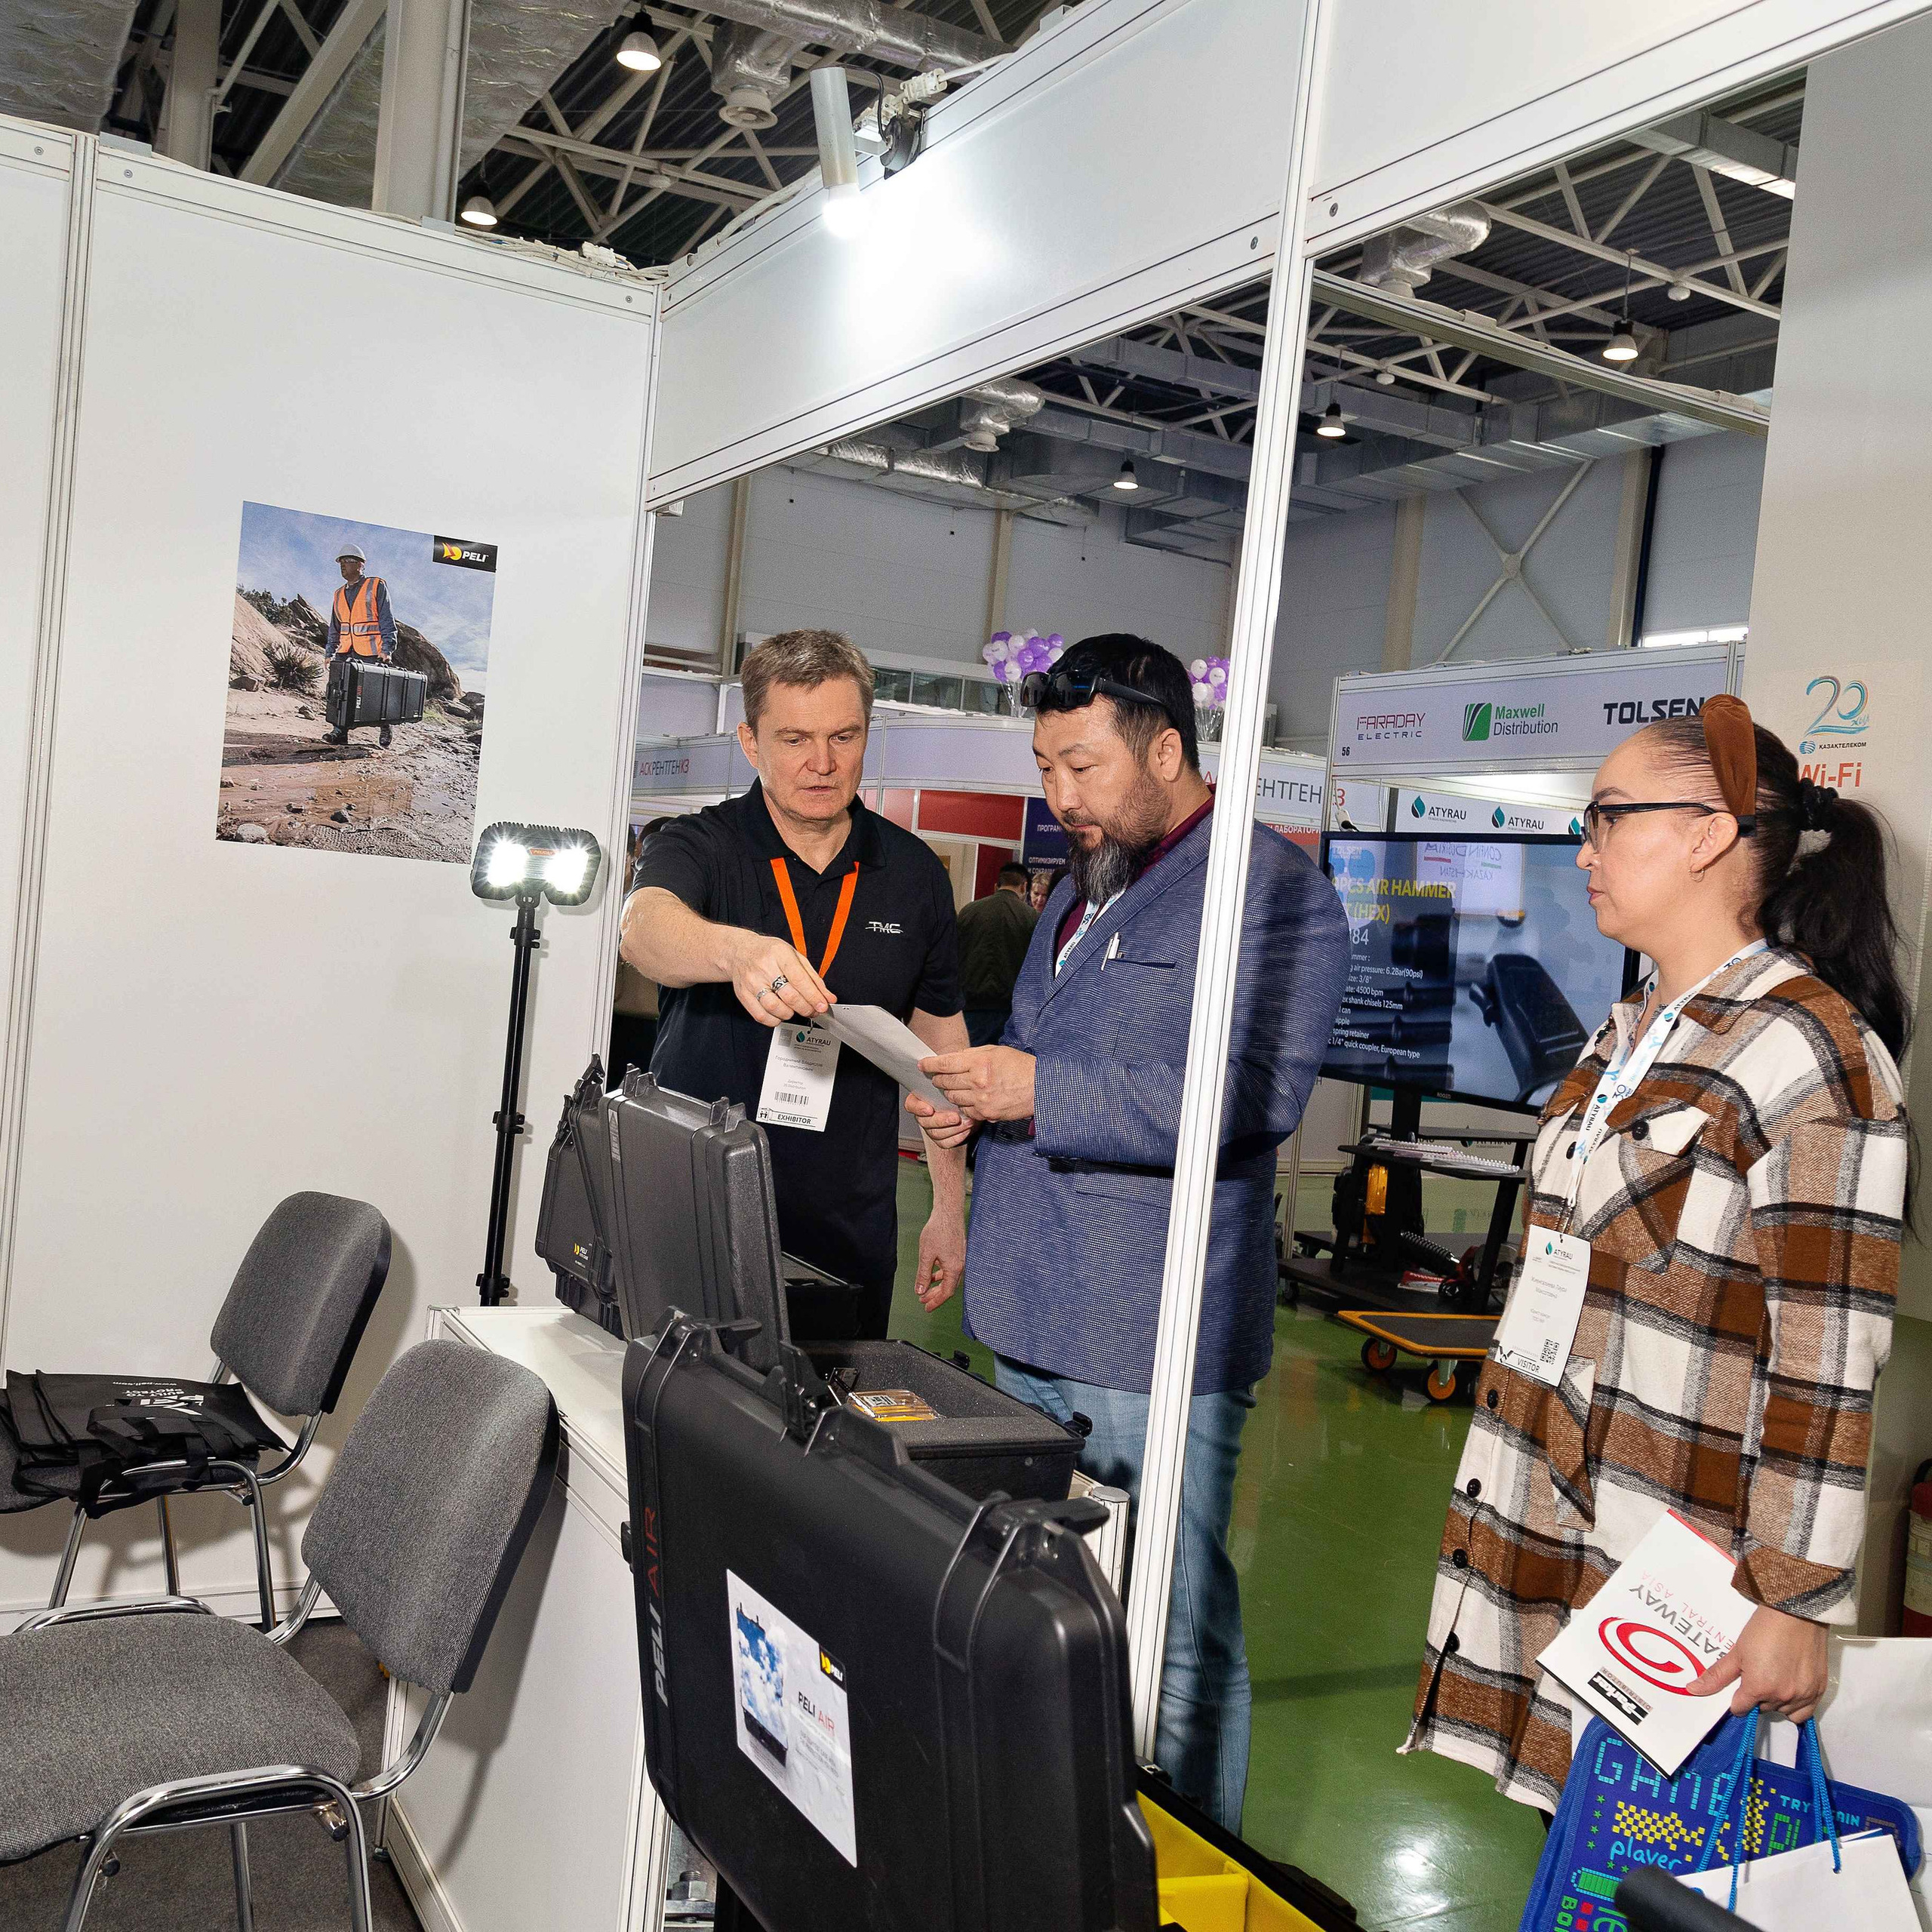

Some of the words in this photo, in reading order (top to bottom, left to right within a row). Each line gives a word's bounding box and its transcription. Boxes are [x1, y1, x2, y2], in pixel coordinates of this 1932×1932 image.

[461, 550, 489, 563] PELI
[1495, 703, 1545, 720] Maxwell
[1603, 697, 1705, 725] TOLSEN
[1357, 712, 1426, 730] FARADAY
[1493, 721, 1558, 736] Distribution
[1358, 731, 1422, 740] ELECTRIC
[1342, 747, 1350, 756] 56
[1798, 762, 1862, 788] Wi-Fi
[1428, 807, 1466, 820] ATYRAU
[1508, 817, 1544, 829] ATYRAU
[1367, 878, 1389, 896] AIR
[1391, 879, 1457, 899] HAMMER
[1349, 928, 1369, 945] 84
[1361, 965, 1386, 975] pressure:
[1355, 986, 1371, 995] 4500
[1371, 987, 1384, 996] bpm
[1349, 996, 1364, 1005] shank
[1364, 998, 1382, 1008] chisels
[1383, 1000, 1403, 1011] 125mm
[806, 1036, 832, 1046] ATYRAU
[1349, 1029, 1370, 1039] retainer
[1344, 1040, 1358, 1049] quick
[1358, 1043, 1380, 1053] coupler,
[1380, 1044, 1407, 1057] European
[1407, 1049, 1420, 1059] type
[777, 1114, 811, 1124] EXHIBITOR
[1554, 1249, 1574, 1260] ATYRAU
[1517, 1358, 1541, 1373] VISITOR
[645, 1507, 660, 1598] AIR
[1681, 1601, 1735, 1651] ENTRAL
[649, 1601, 669, 1707] PELI
[798, 1691, 816, 1718] PELI
[818, 1710, 835, 1733] AIR
[1780, 1795, 1811, 1813] TRY
